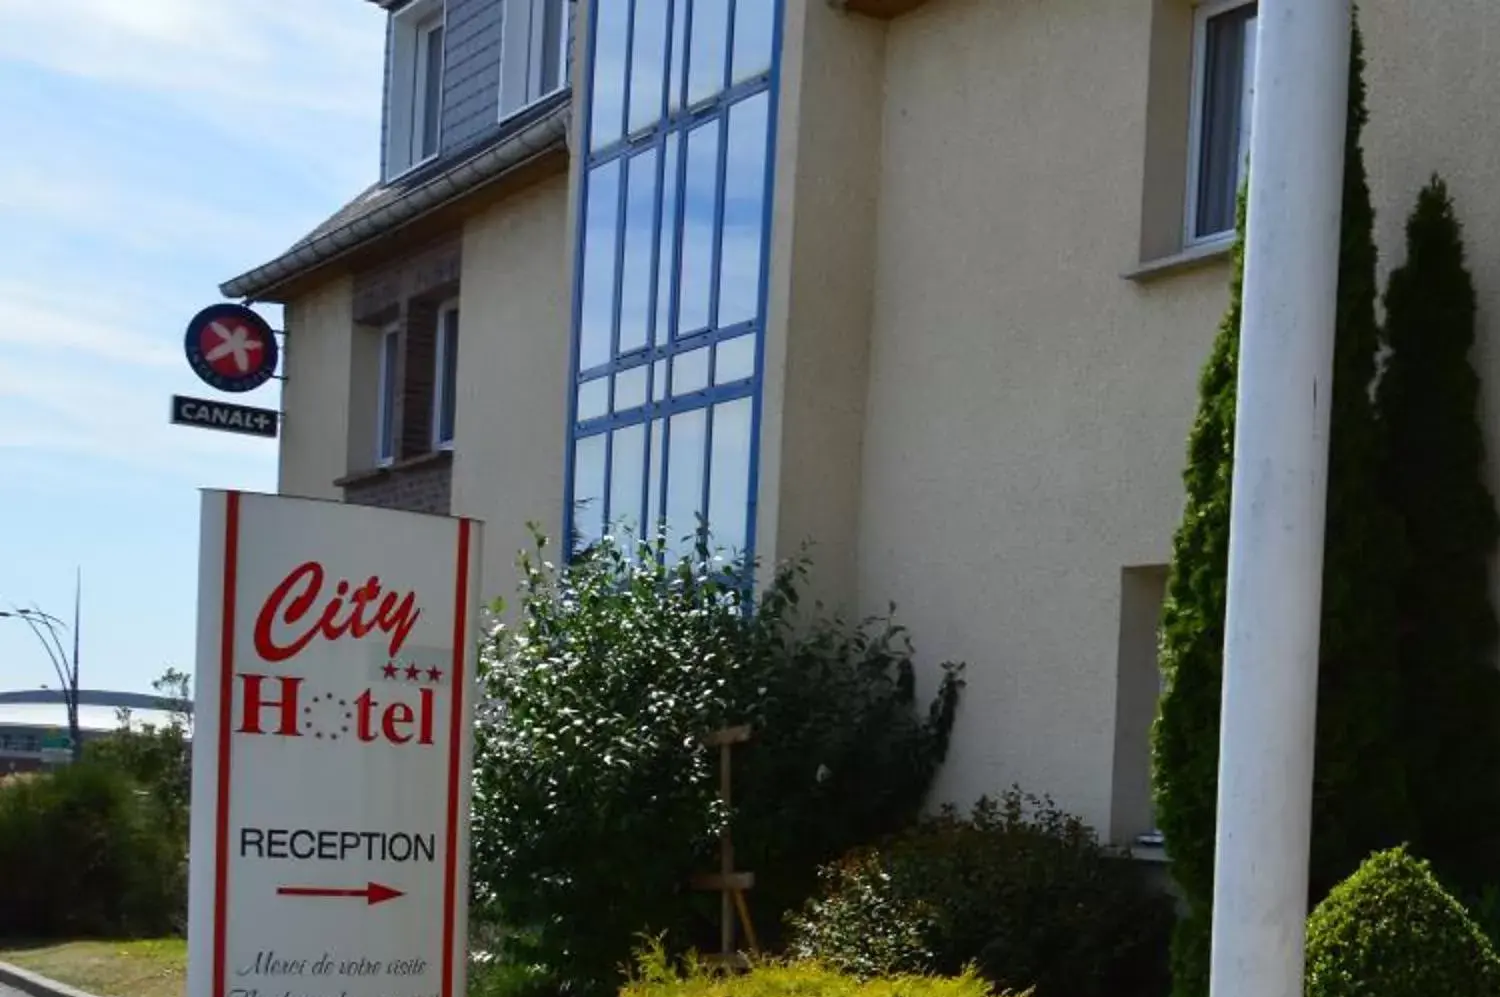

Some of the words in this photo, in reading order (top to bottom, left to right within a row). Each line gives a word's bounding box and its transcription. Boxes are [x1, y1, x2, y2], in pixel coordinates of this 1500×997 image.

[180, 402, 271, 430] CANAL+
[253, 561, 421, 662] City
[240, 828, 436, 862] RECEPTION
[235, 950, 308, 976] Merci
[311, 951, 335, 976] de
[339, 957, 382, 976] votre
[386, 957, 427, 976] visite
